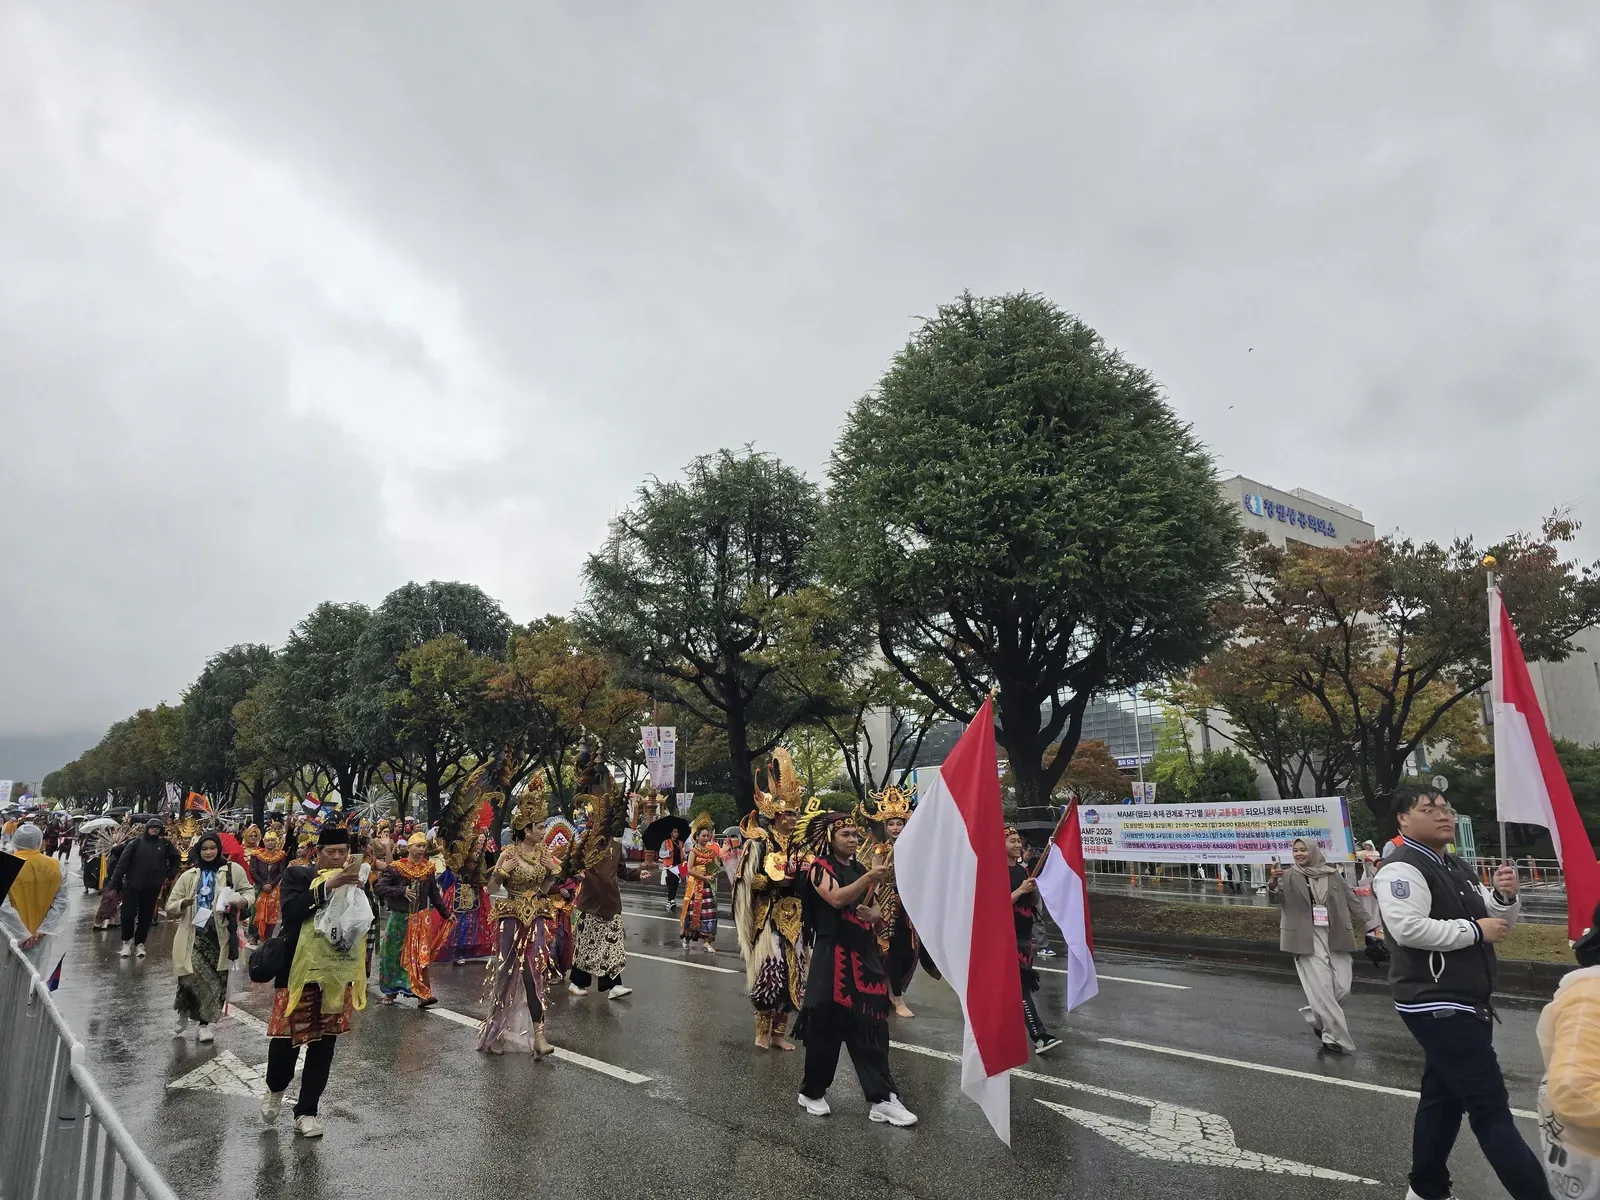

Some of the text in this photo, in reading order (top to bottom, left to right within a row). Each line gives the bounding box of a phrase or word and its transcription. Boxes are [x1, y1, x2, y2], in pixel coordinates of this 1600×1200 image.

[1117, 810, 1151, 819] MAMF(맘프)
[1153, 810, 1165, 818] 축제
[1185, 809, 1203, 818] 구간별
[1204, 808, 1217, 817] 일부
[1218, 808, 1245, 817] 교통통제
[1245, 807, 1266, 816] 되오니
[1267, 806, 1281, 815] 양해
[1282, 804, 1328, 815] 부탁드립니다.
[1081, 836, 1113, 845] 원중앙대로
